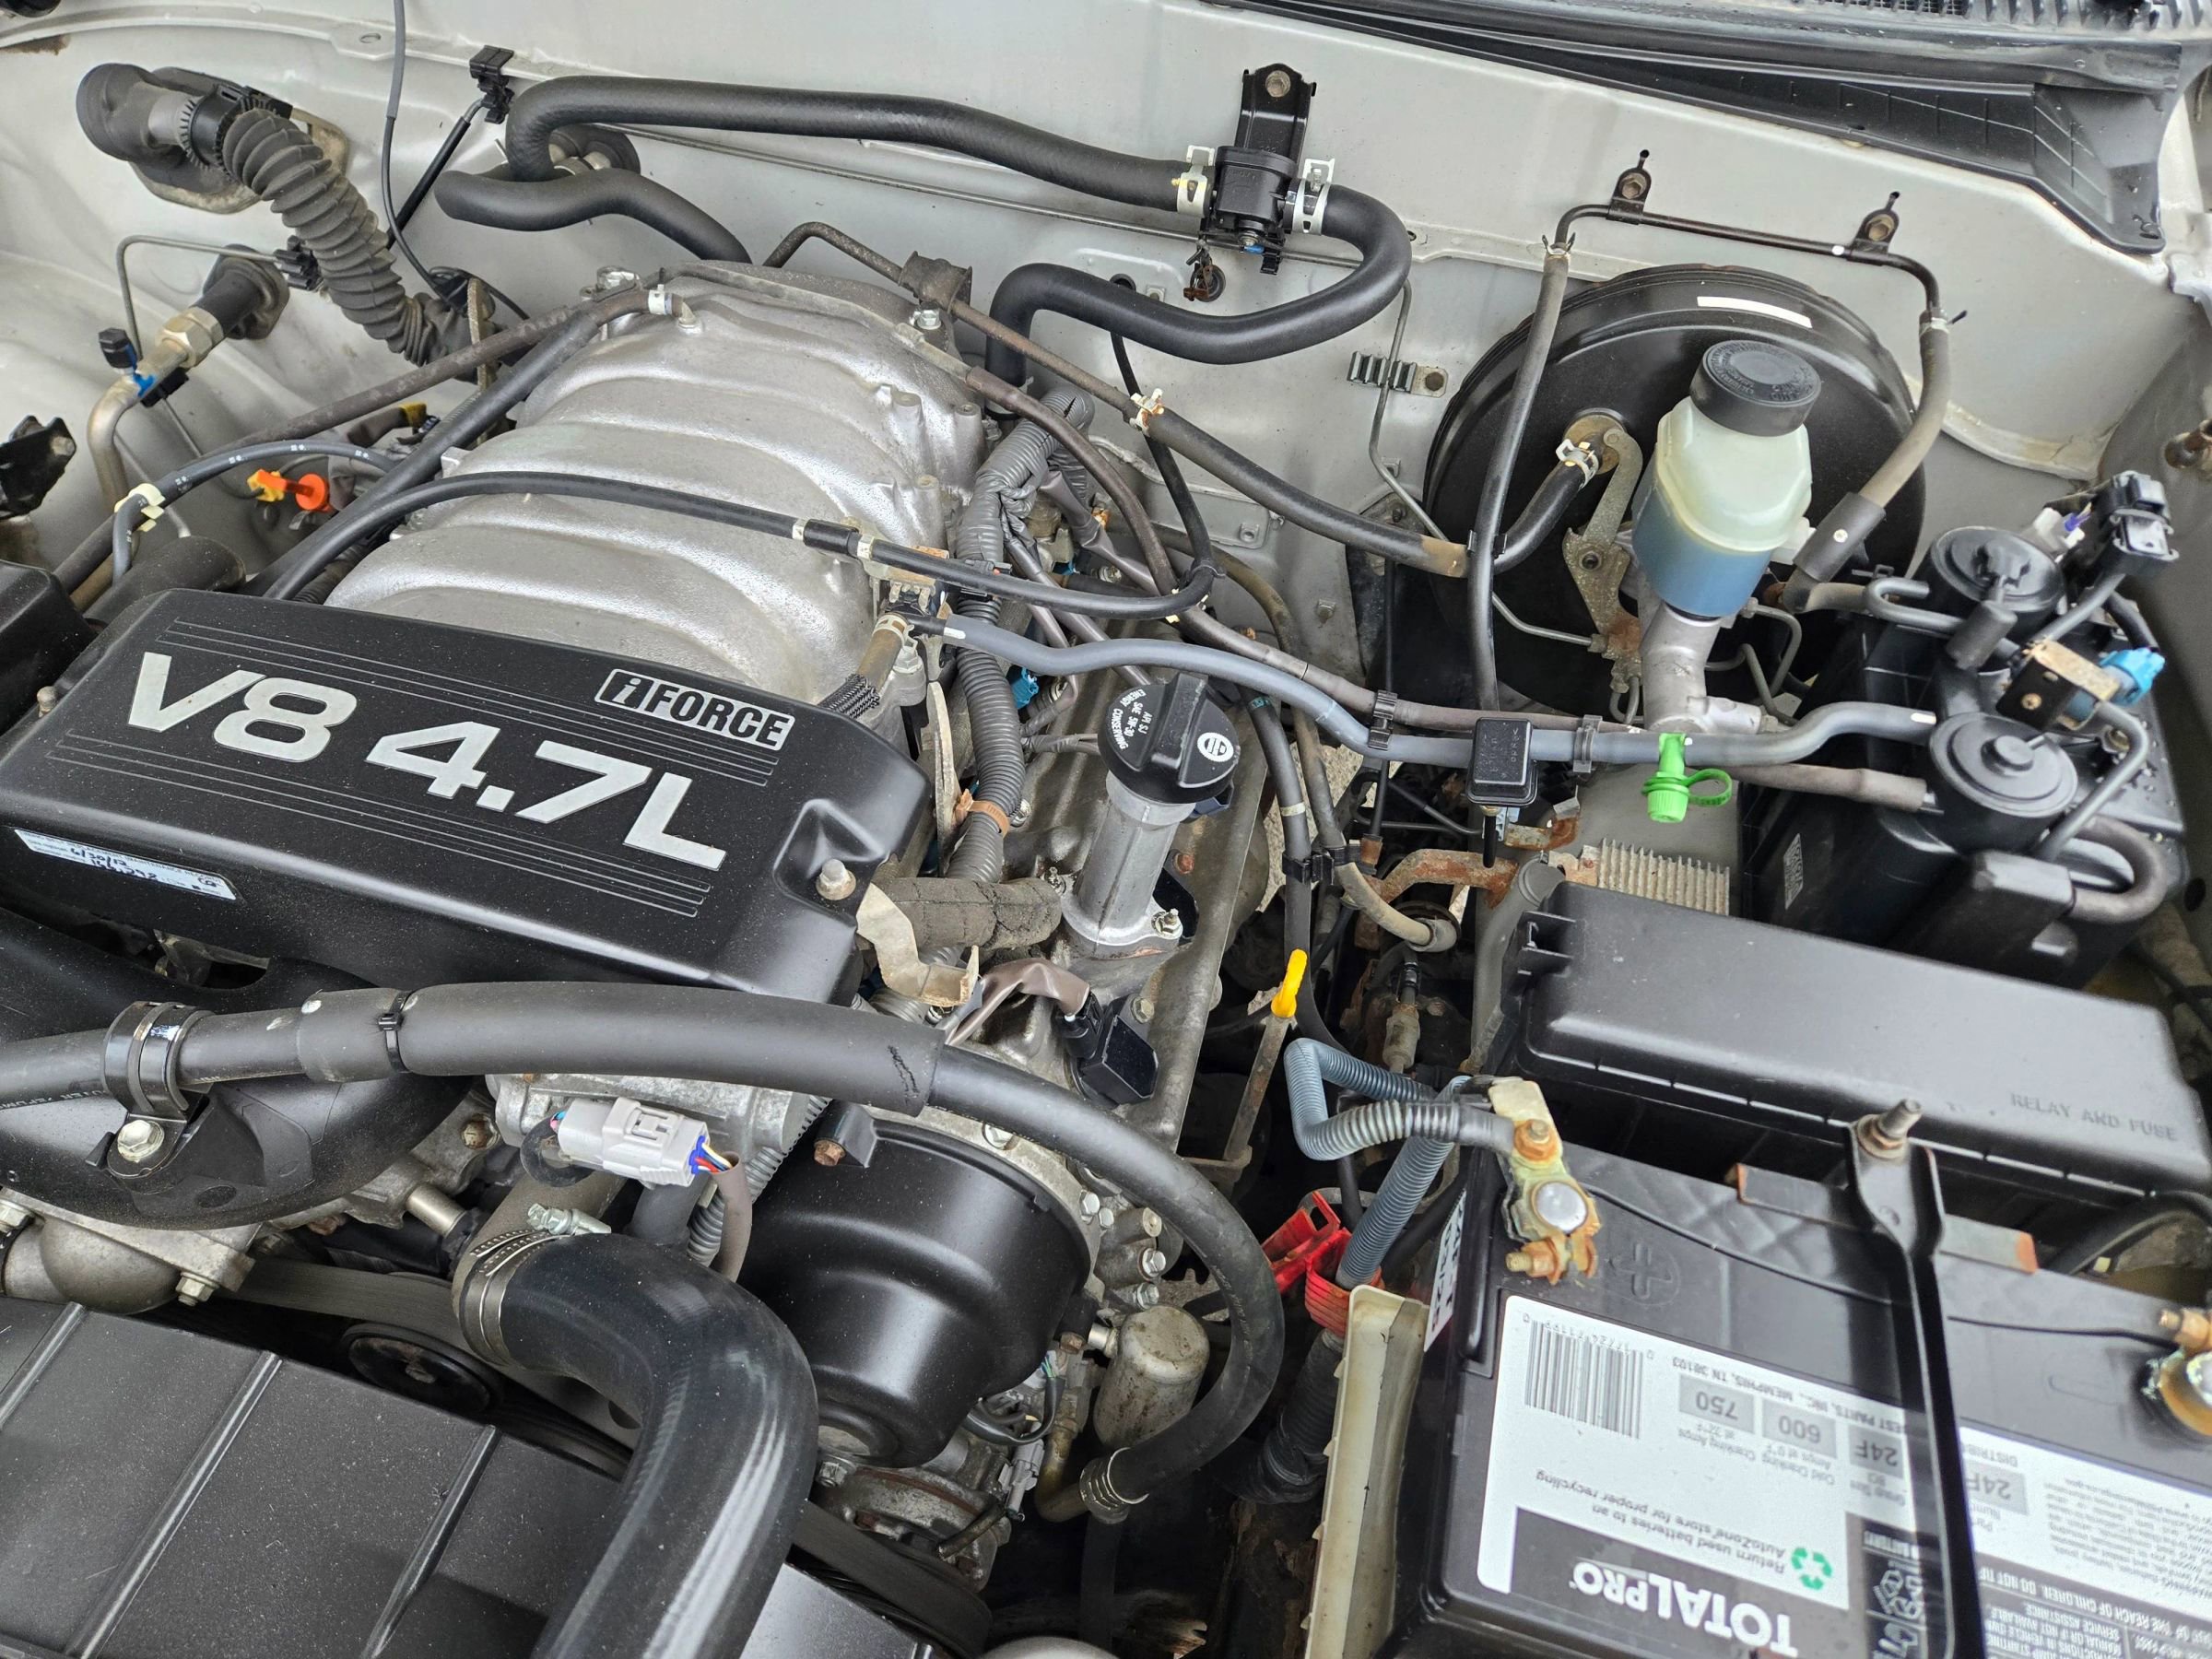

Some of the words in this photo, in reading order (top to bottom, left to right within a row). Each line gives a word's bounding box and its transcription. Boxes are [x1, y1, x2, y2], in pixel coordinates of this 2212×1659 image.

[1119, 688, 1147, 708] ENERGY
[1131, 700, 1144, 715] SAE
[1111, 707, 1129, 750] CONSERVING
[1123, 715, 1139, 737] 5W-30
[1140, 711, 1153, 724] API
[126, 651, 359, 763] V8
[365, 720, 727, 871] 4.7L
[2010, 1093, 2071, 1118] RELAY
[2081, 1108, 2121, 1129] AND
[2129, 1118, 2179, 1142] FUSE
[1694, 1389, 1738, 1421] 750
[1778, 1413, 1821, 1446] 600
[1854, 1436, 1898, 1468] 24F
[1534, 1467, 1597, 1501] recycling
[1601, 1488, 1648, 1514] proper
[1630, 1516, 1692, 1546] batteries
[1675, 1514, 1711, 1535] store
[1697, 1536, 1731, 1558] used
[1735, 1548, 1783, 1575] Return
[1995, 1570, 2018, 1591] NOT
[2018, 1576, 2036, 1595] DO
[1571, 1559, 1796, 1656] TOTALPRO
[2114, 1604, 2150, 1630] REACH
[2082, 1618, 2119, 1641] SERVICE
